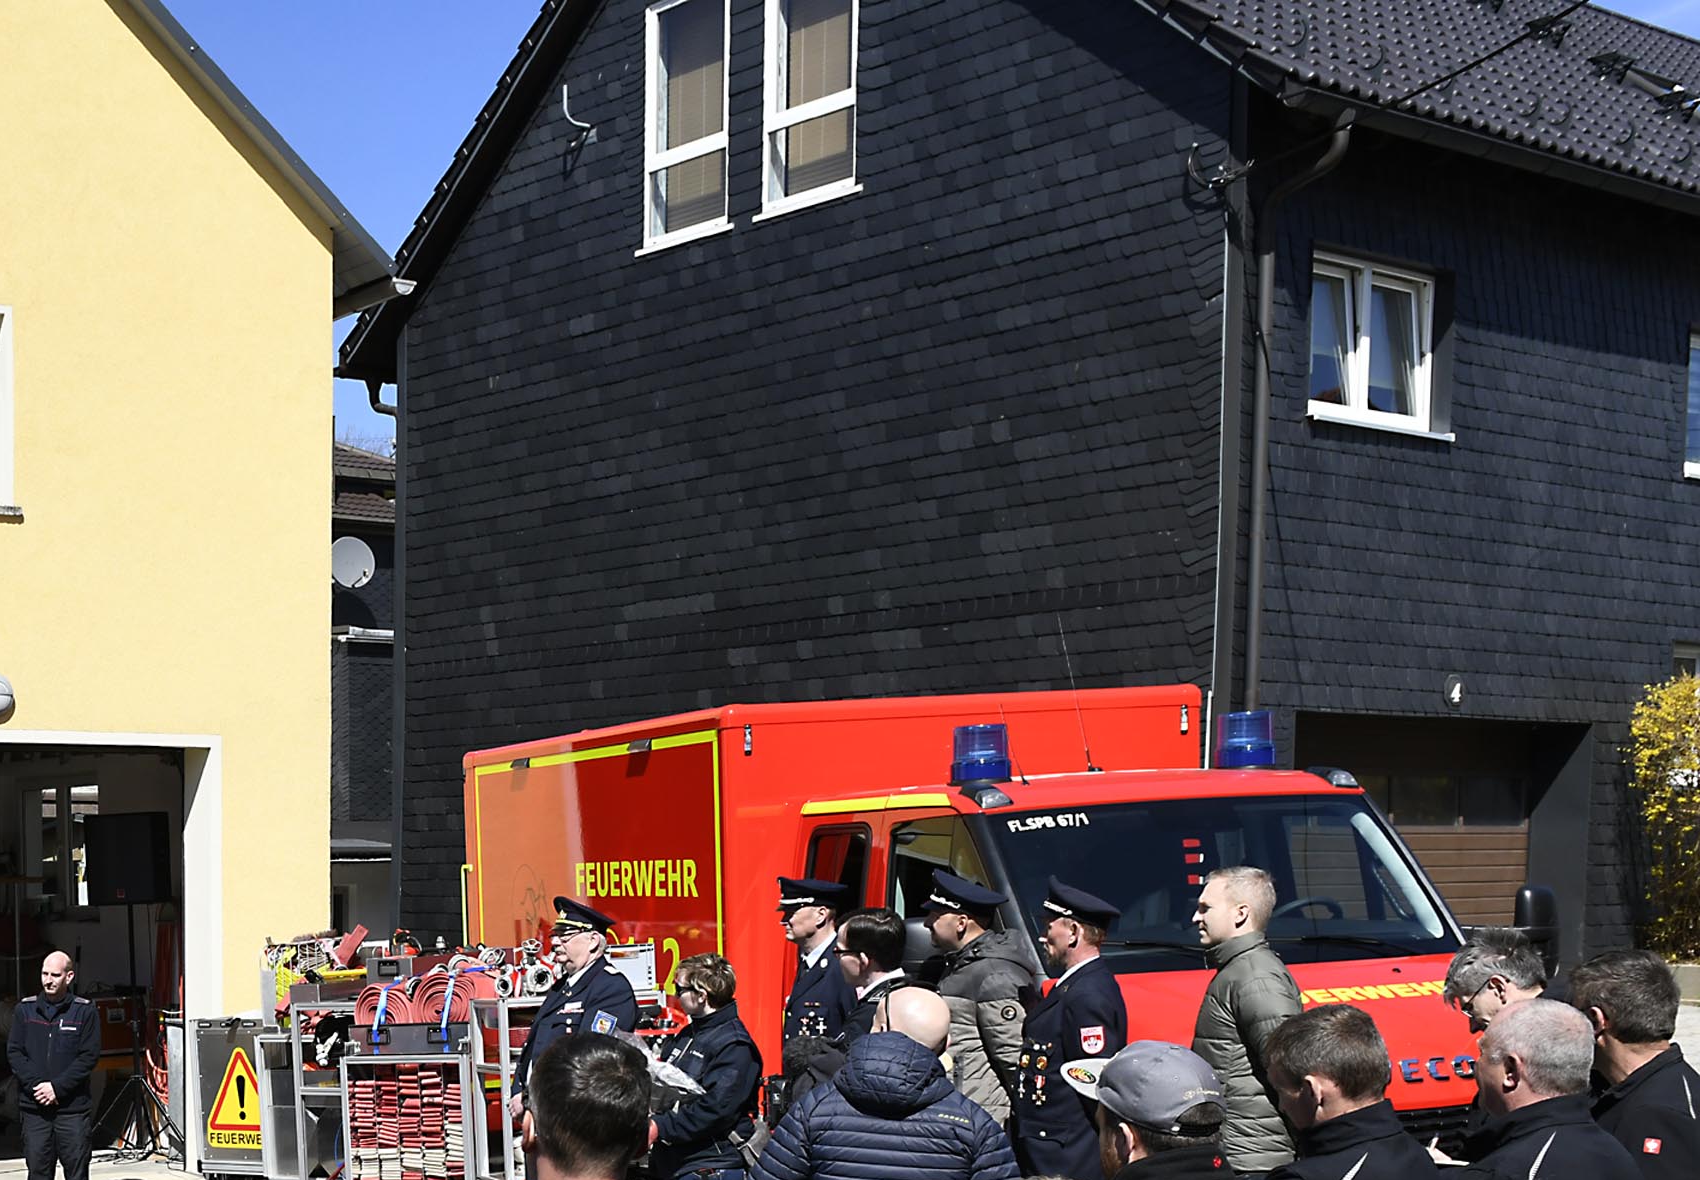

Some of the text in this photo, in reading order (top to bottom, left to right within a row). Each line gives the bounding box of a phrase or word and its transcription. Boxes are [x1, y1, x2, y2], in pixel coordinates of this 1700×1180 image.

[1450, 682, 1461, 702] 4
[1057, 812, 1089, 827] 67/1
[575, 858, 699, 898] FEUERWEHR
